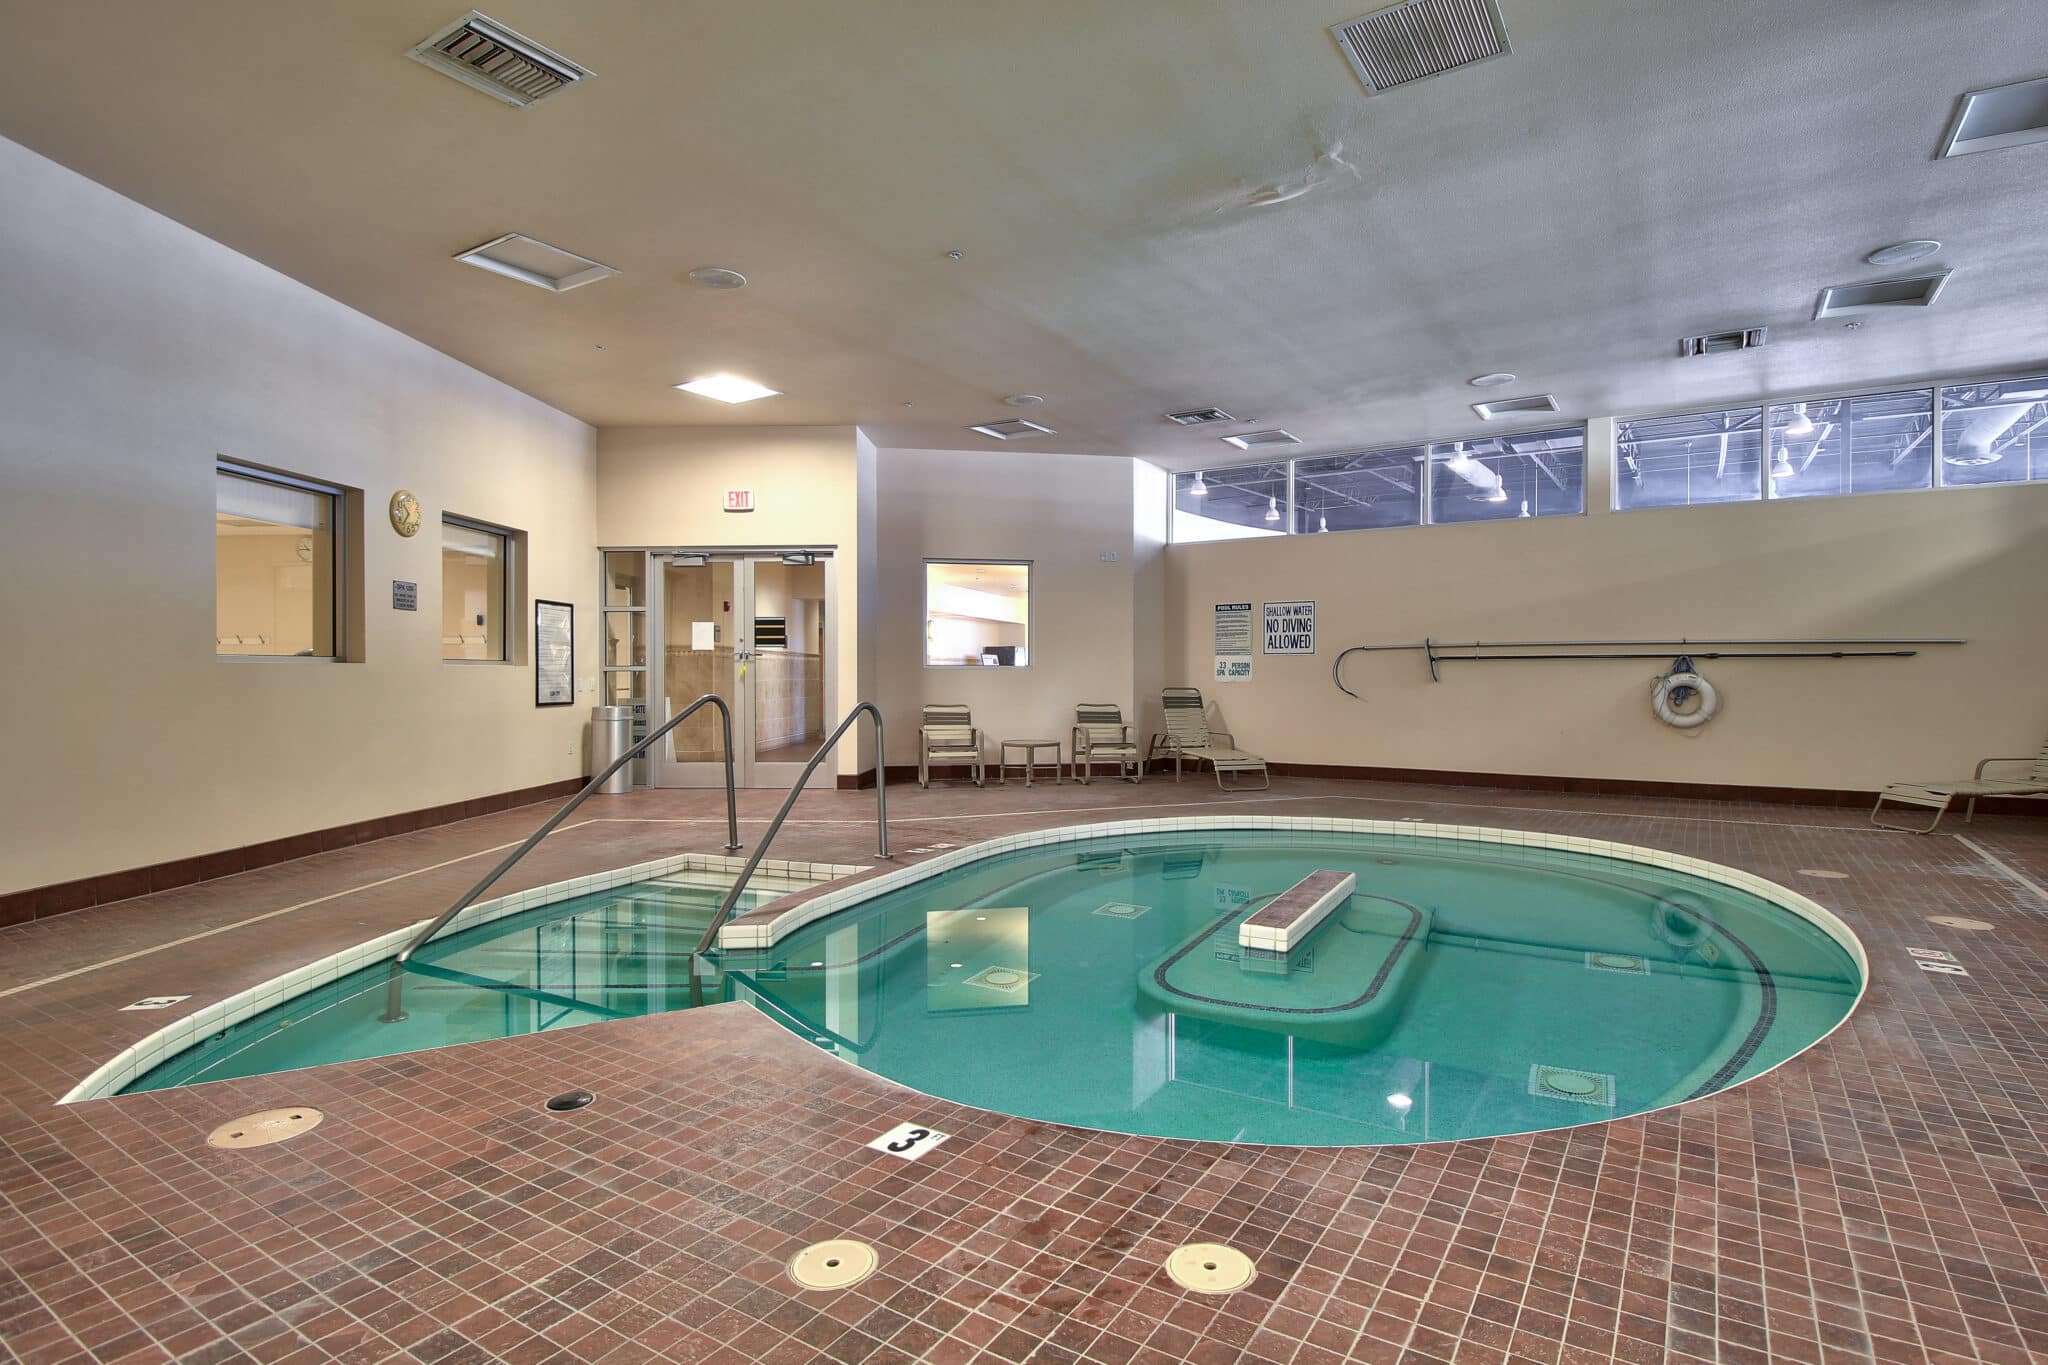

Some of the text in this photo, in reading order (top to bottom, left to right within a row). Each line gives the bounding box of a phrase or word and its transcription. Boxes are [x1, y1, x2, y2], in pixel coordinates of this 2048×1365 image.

[728, 491, 750, 507] EXIT
[1265, 605, 1313, 616] SHALLOW WATER
[1266, 618, 1312, 633] NO DIVING
[1267, 634, 1311, 649] ALLOWED
[887, 1129, 930, 1152] 3
